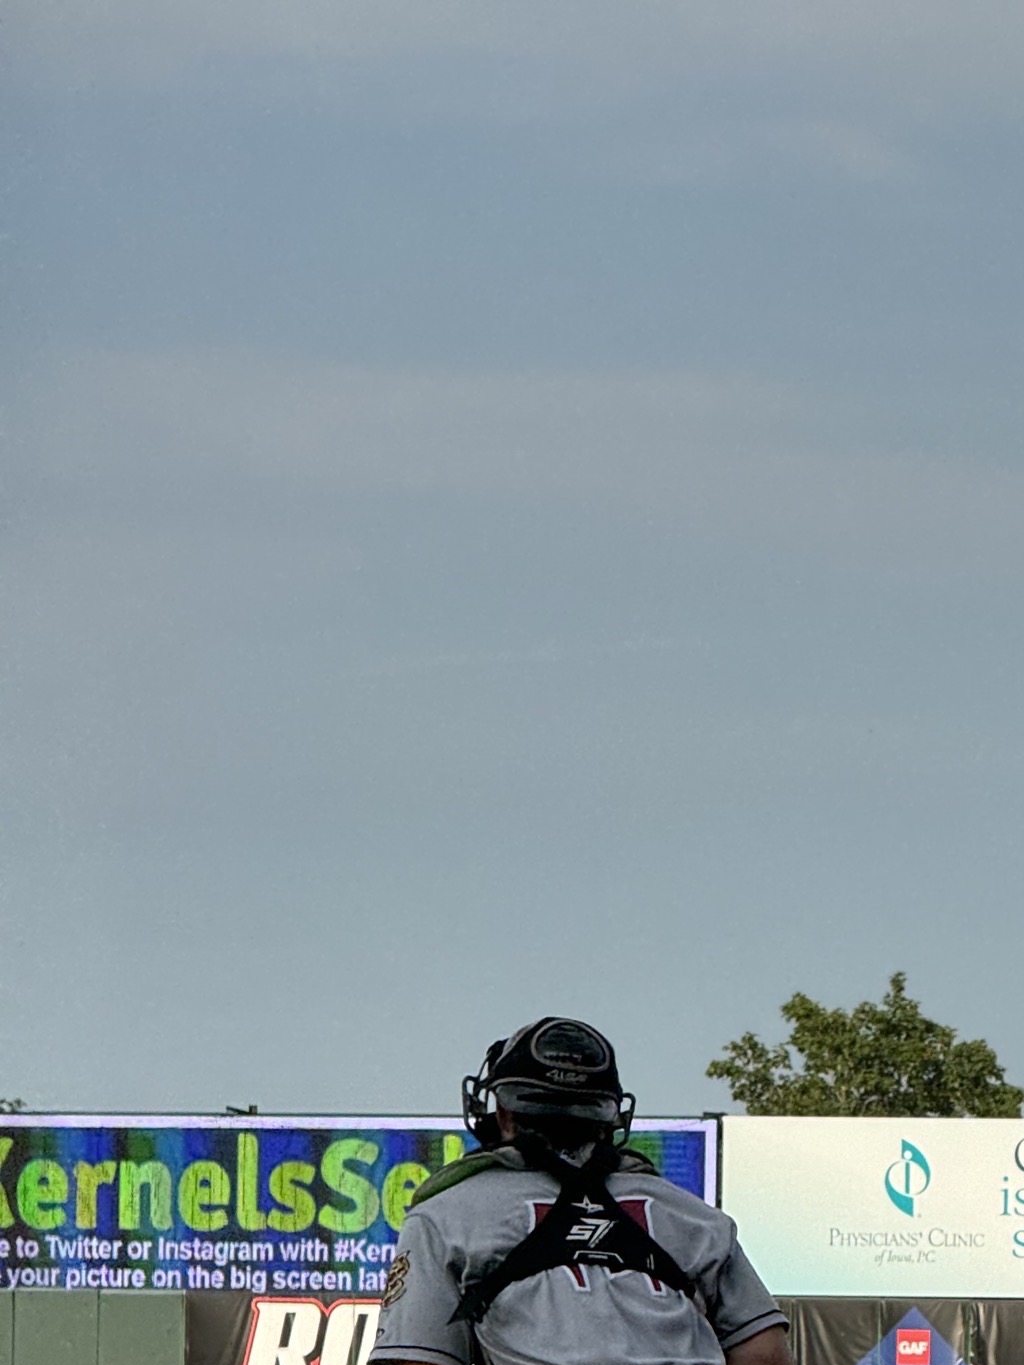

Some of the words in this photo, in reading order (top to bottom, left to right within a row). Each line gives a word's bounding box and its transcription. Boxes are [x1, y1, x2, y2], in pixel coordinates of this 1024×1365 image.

[0, 1131, 465, 1233] ernelsSe
[15, 1235, 40, 1259] to
[45, 1234, 121, 1260] Twitter
[127, 1240, 153, 1260] or
[158, 1236, 274, 1267] Instagram
[279, 1237, 329, 1262] with
[6, 1267, 60, 1290] your
[66, 1263, 146, 1290] picture
[151, 1269, 181, 1288] on
[187, 1265, 224, 1289] the
[230, 1264, 267, 1294] big
[272, 1270, 352, 1290] screen
[898, 1341, 928, 1355] GAF
